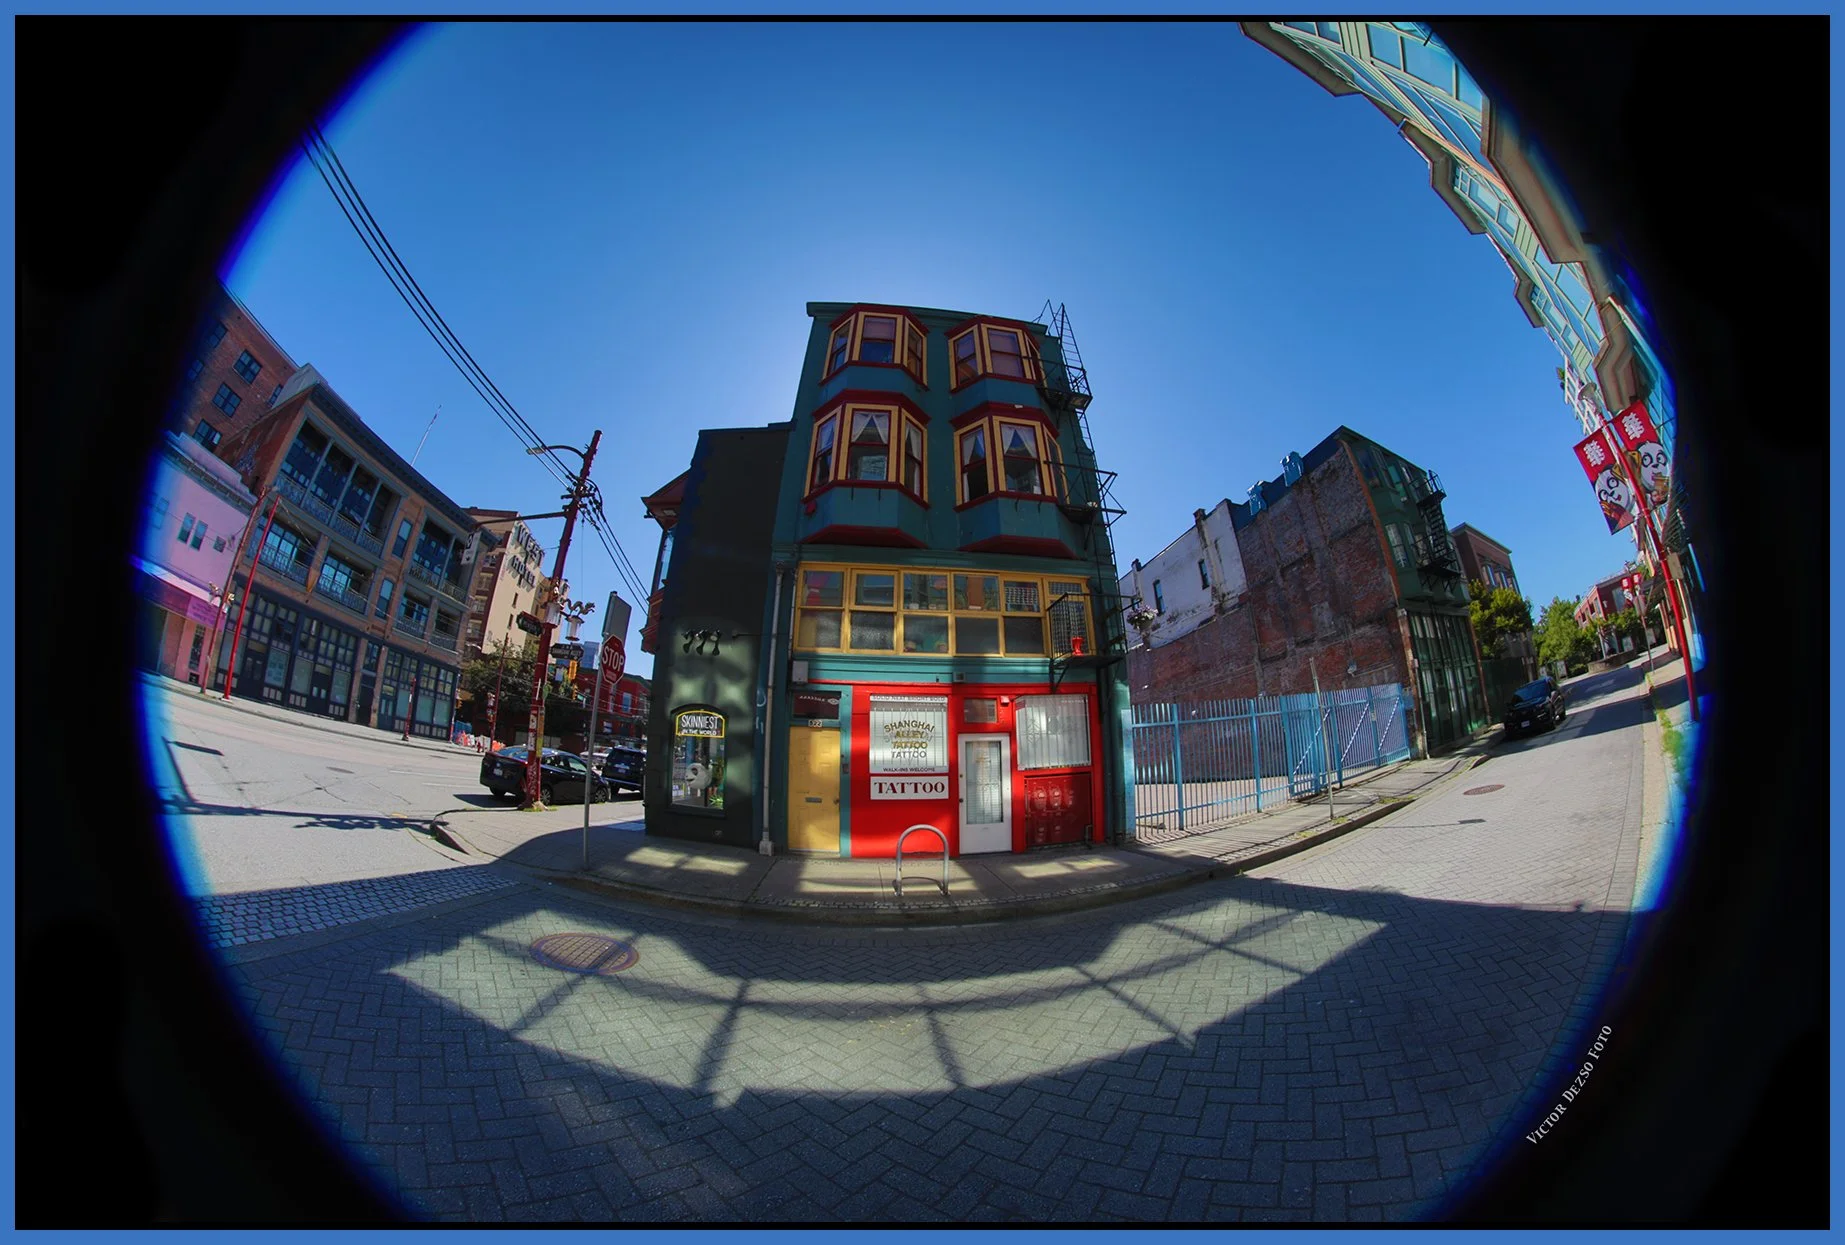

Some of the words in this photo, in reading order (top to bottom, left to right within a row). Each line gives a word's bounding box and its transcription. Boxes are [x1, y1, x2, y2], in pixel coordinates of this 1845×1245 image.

[602, 645, 625, 672] STOP
[681, 715, 718, 729] SKINNIEST
[884, 720, 935, 733] SHANGHAI
[896, 730, 925, 738] ALLEY
[892, 741, 928, 749] TATTOO
[874, 782, 945, 794] TATTOO
